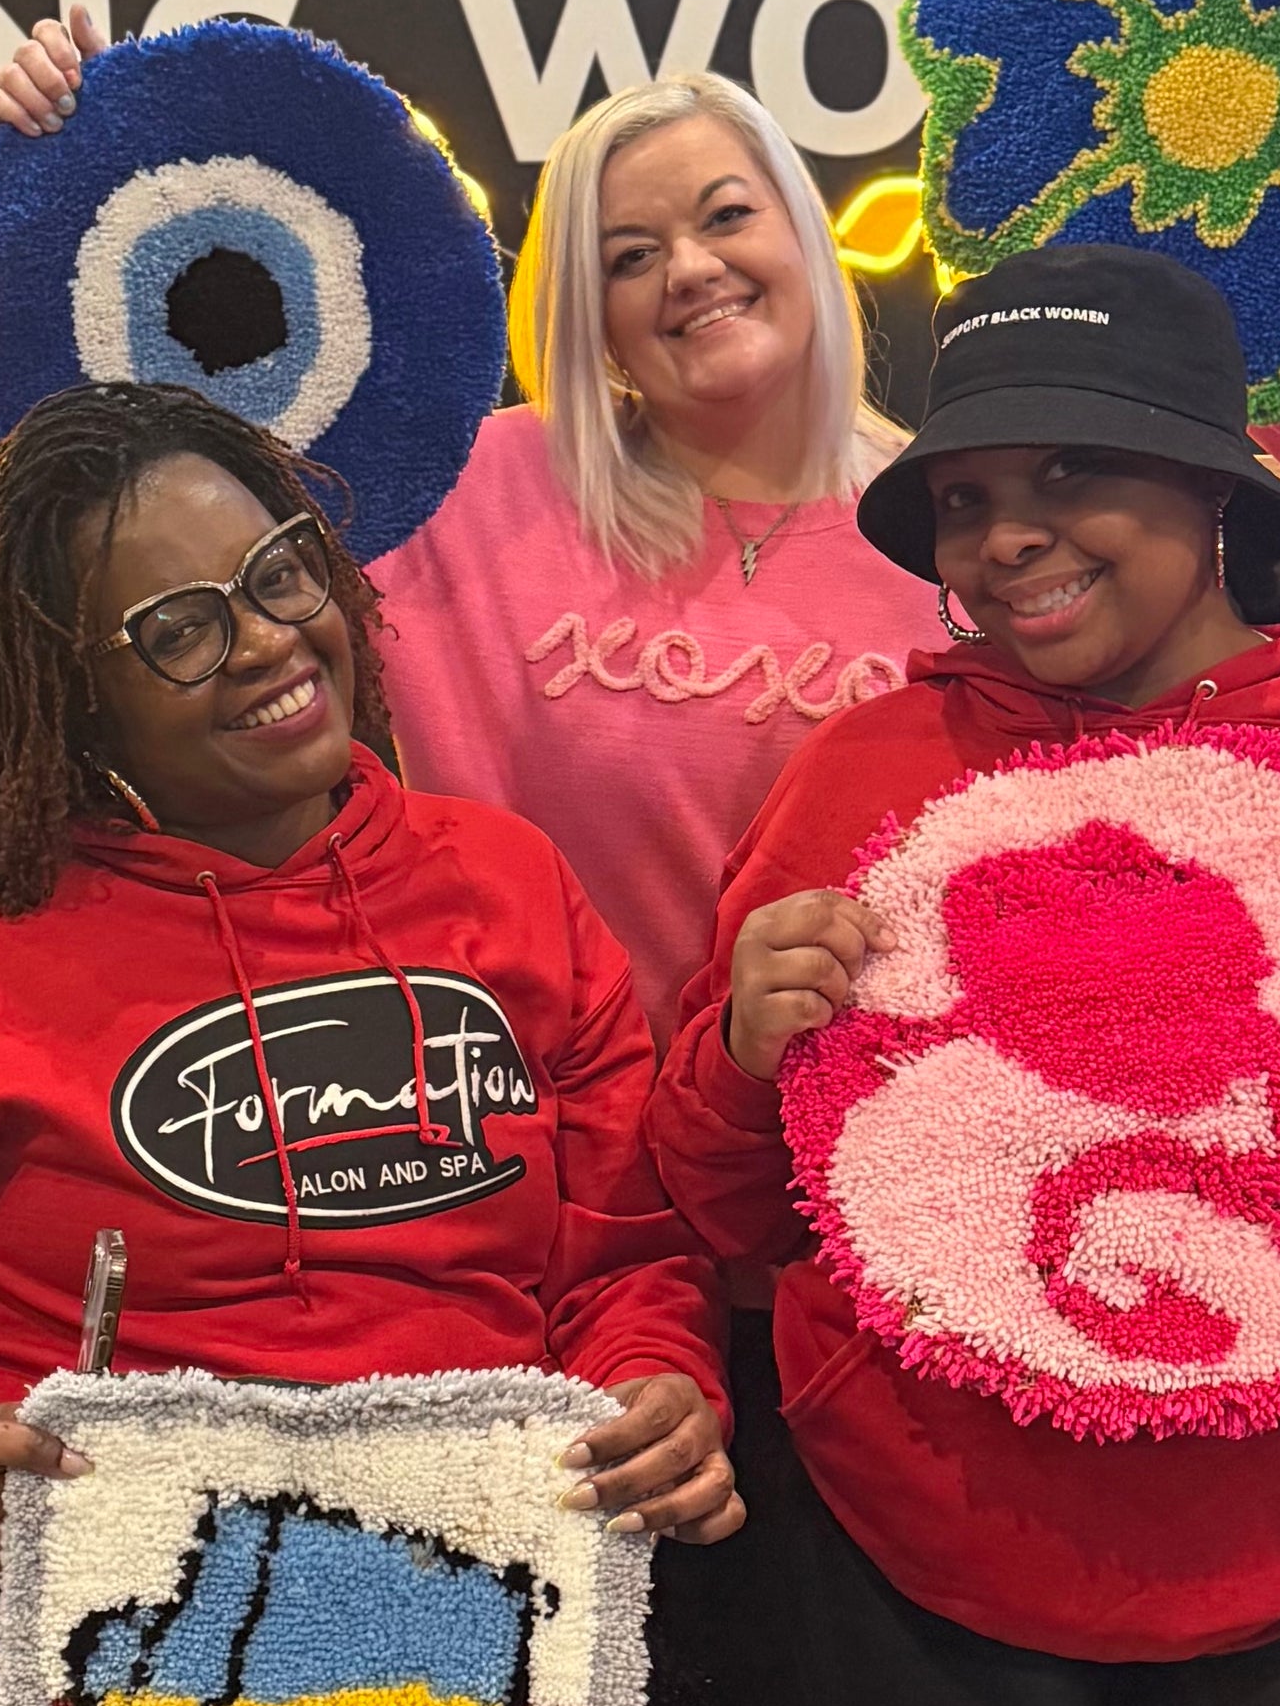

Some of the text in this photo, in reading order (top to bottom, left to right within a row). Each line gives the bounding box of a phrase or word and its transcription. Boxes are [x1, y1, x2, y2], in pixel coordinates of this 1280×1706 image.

[990, 307, 1042, 324] BLACK
[1044, 306, 1110, 325] WOMEN
[524, 612, 908, 725] xoxo
[379, 1161, 428, 1187] AND
[439, 1152, 487, 1178] SPA
